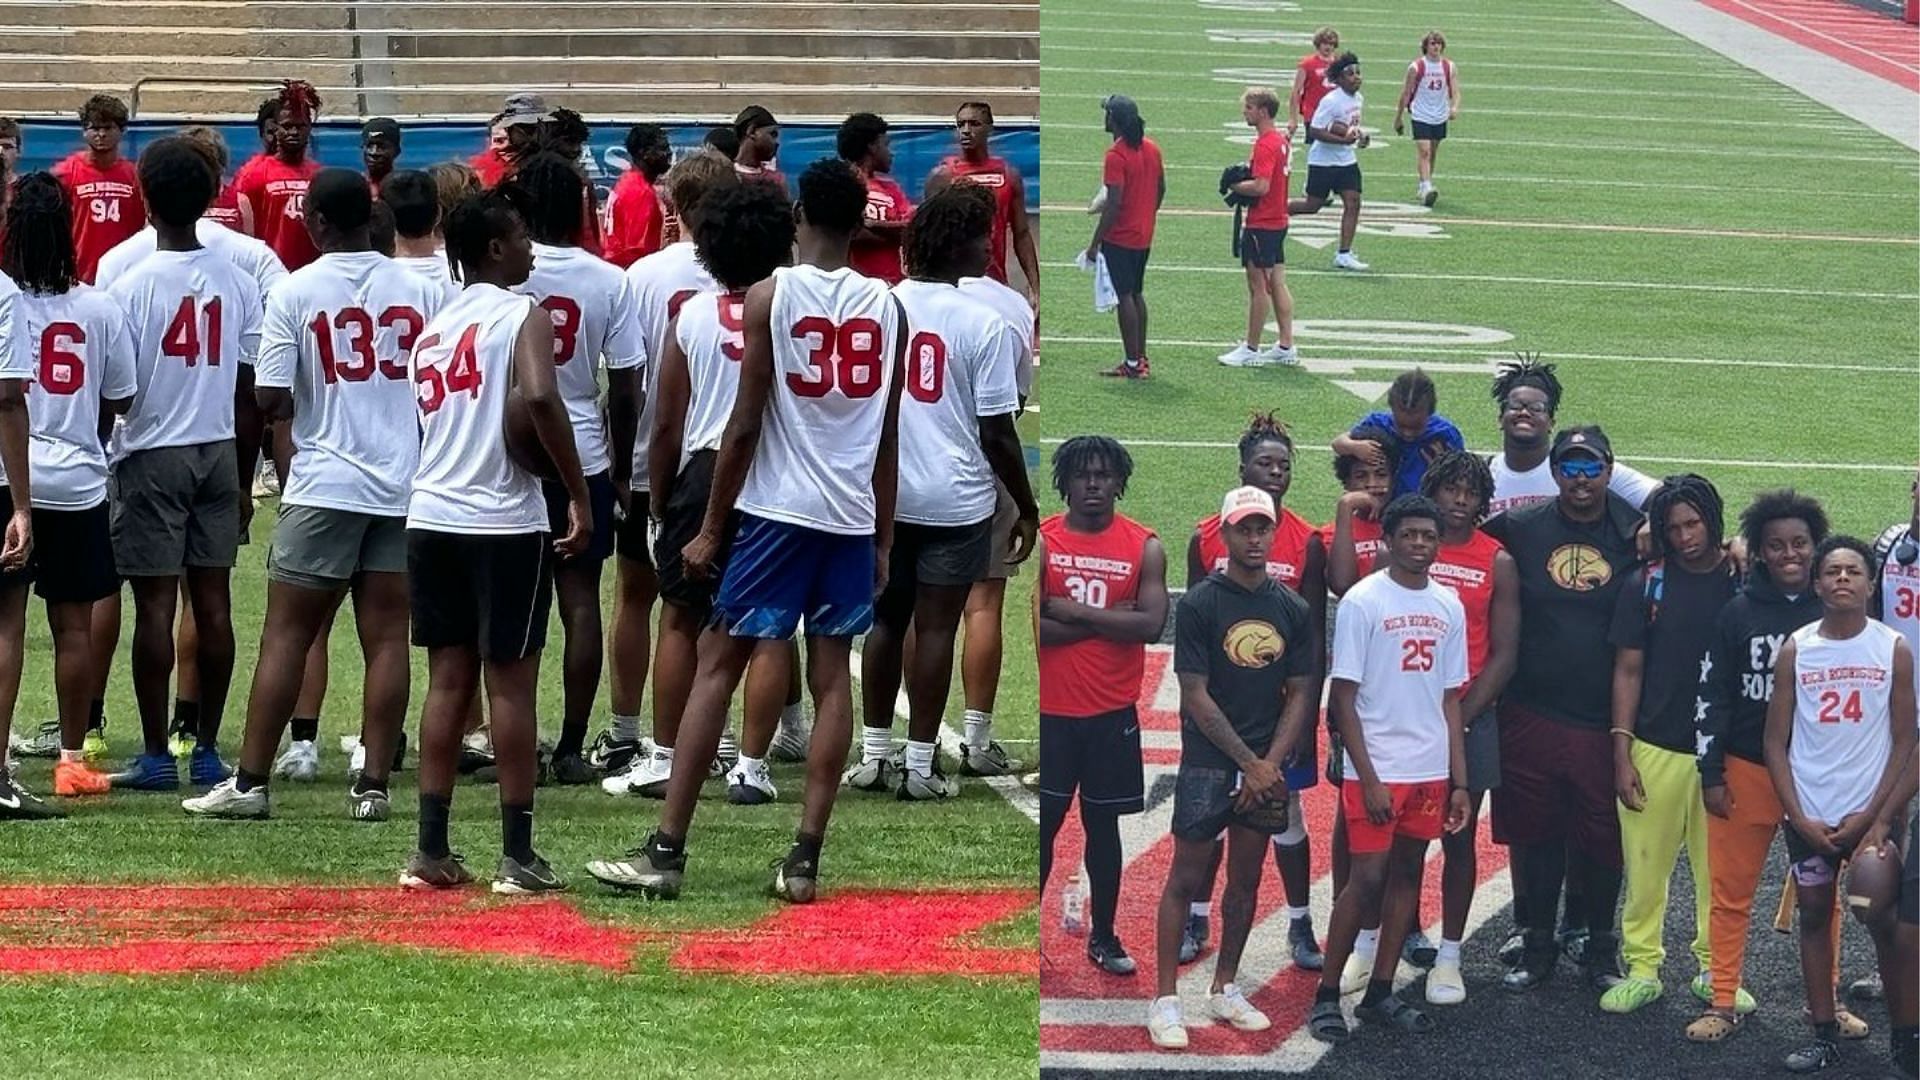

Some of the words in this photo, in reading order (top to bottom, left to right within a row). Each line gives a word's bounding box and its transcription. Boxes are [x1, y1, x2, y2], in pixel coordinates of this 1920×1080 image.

[1427, 79, 1443, 91] 43
[90, 198, 121, 223] 94
[161, 295, 223, 368] 41
[308, 305, 425, 385] 133
[415, 322, 483, 416] 54
[786, 315, 883, 398] 38
[1065, 575, 1108, 609] 30
[1895, 587, 1920, 619] 3
[1402, 639, 1437, 672] 25
[1819, 690, 1864, 724] 24
